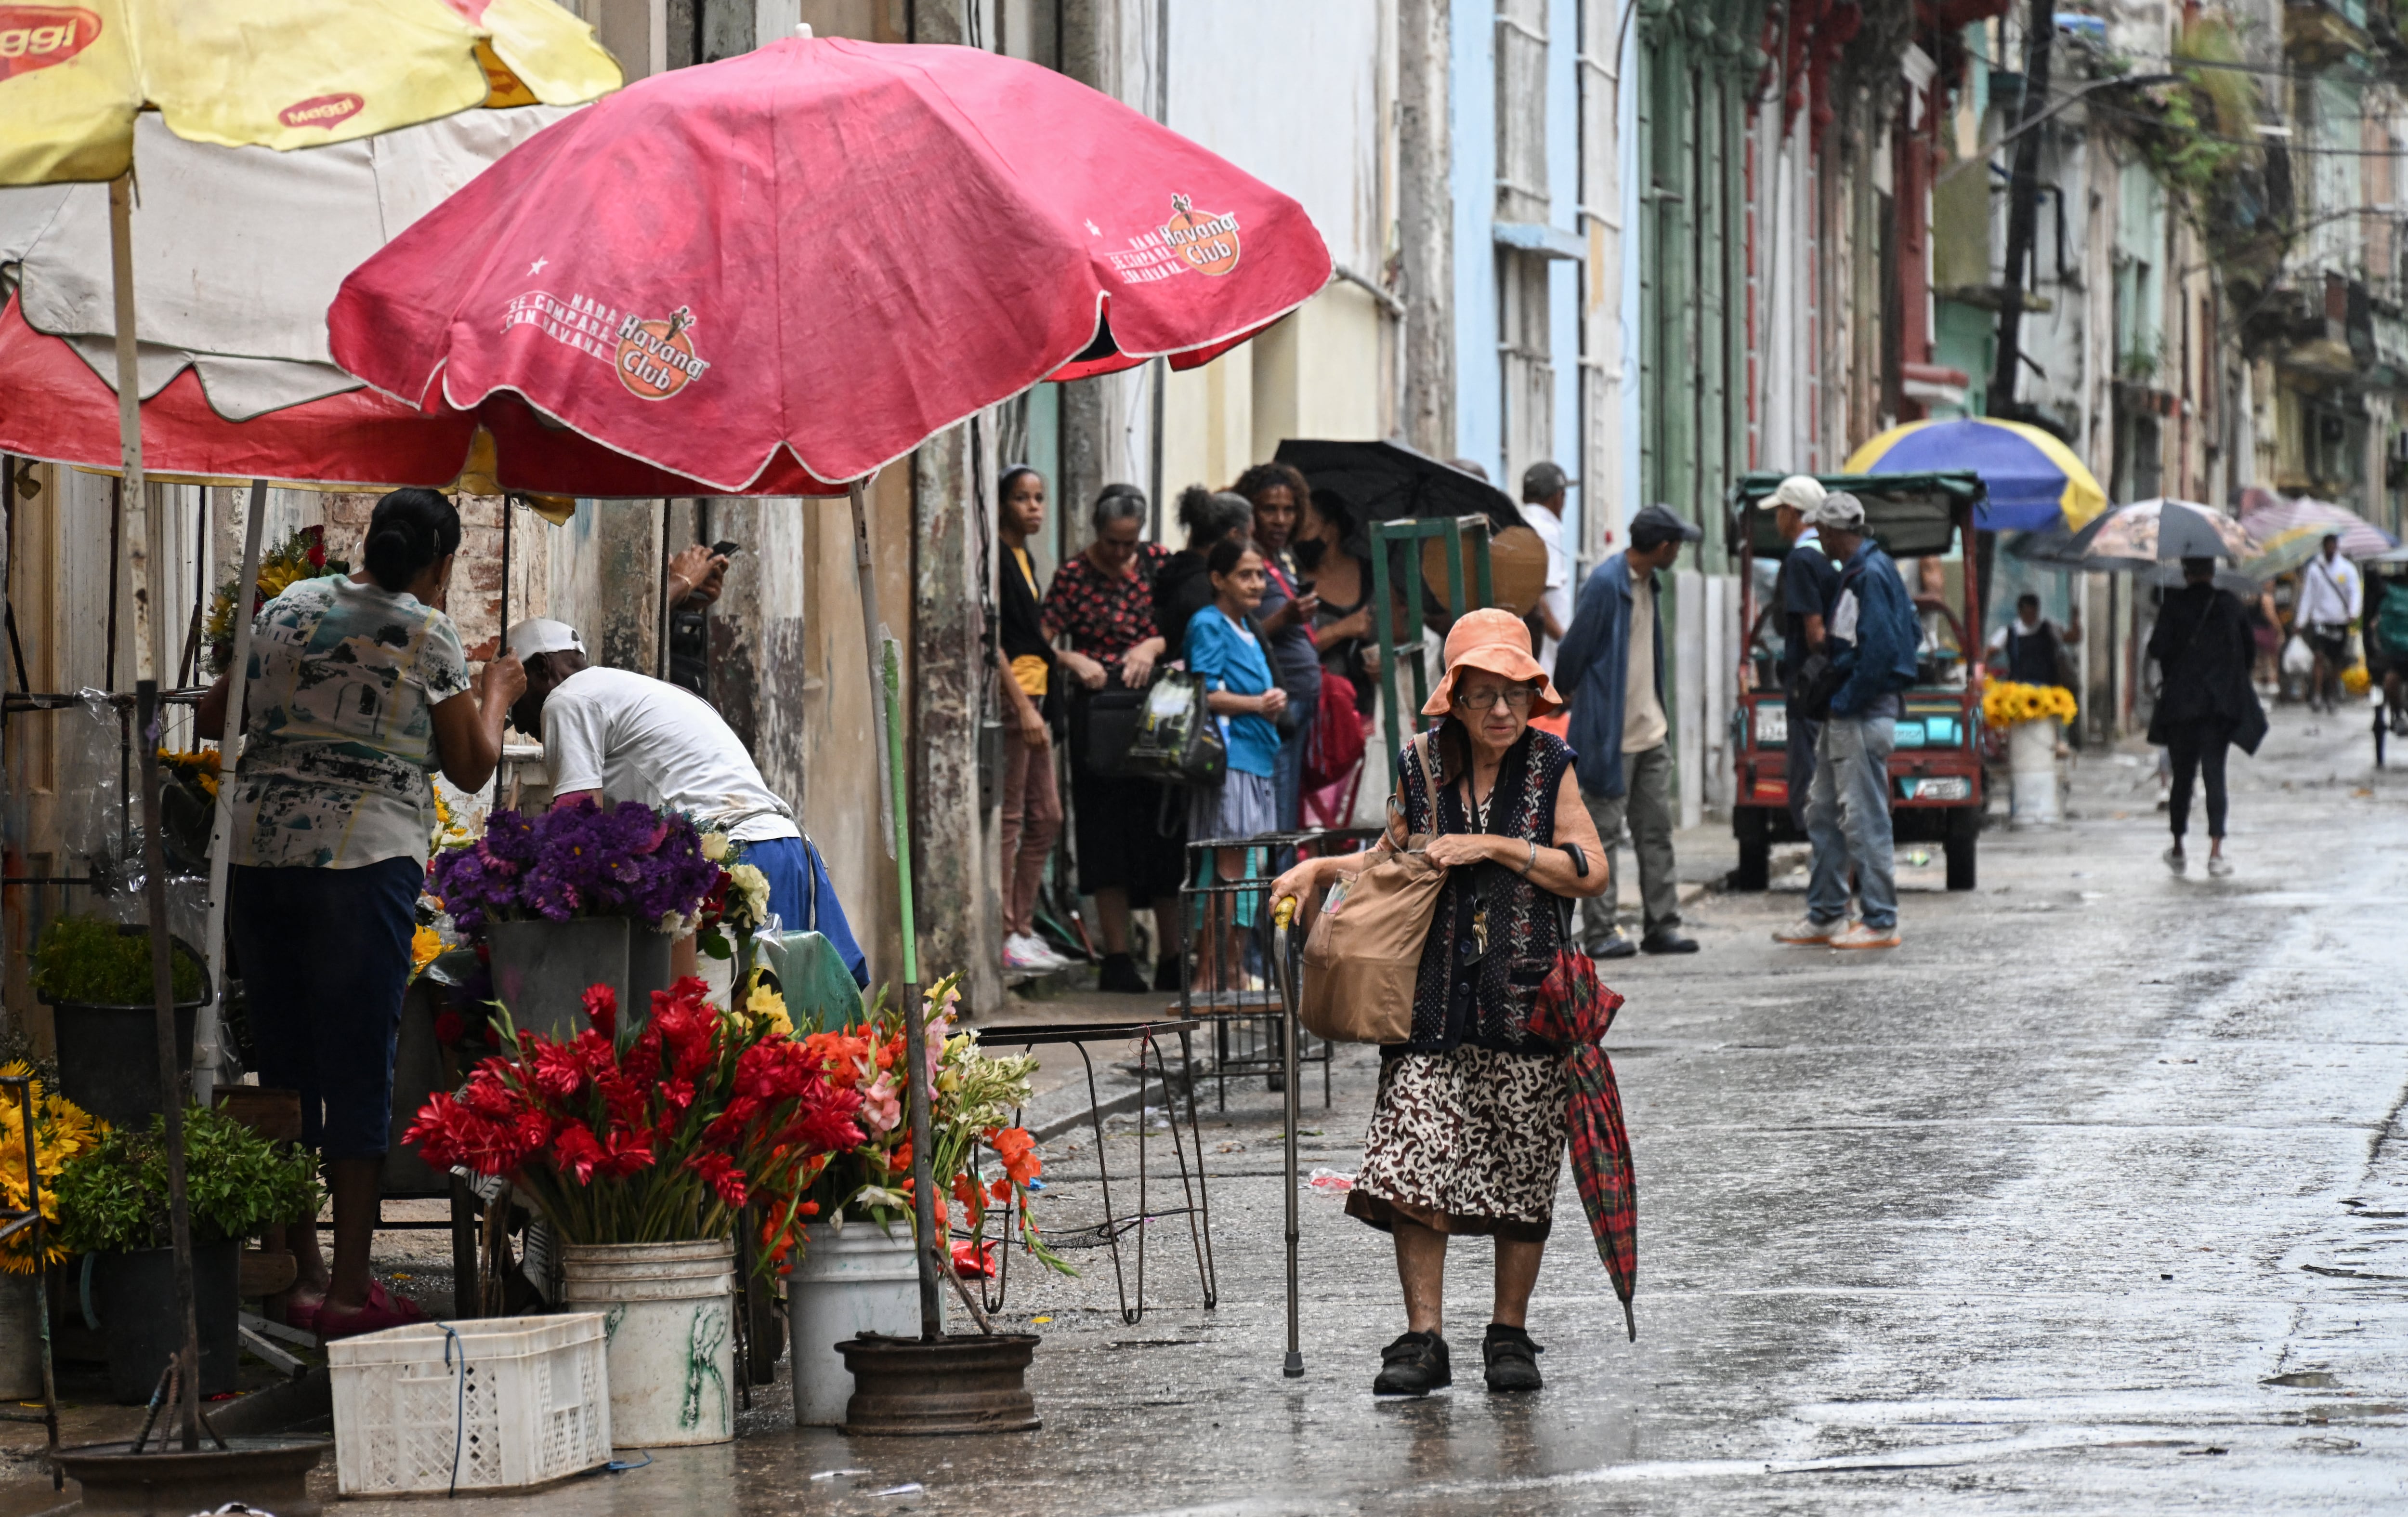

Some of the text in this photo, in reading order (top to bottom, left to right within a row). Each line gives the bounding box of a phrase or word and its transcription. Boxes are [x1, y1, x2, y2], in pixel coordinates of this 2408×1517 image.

[287, 97, 355, 125] Maggi
[1158, 215, 1238, 247] Havana
[1186, 239, 1232, 264] Club
[509, 294, 610, 342] SE COMPARA
[570, 293, 617, 325] NADA
[506, 309, 604, 356] CON HAVANA
[616, 313, 704, 379] Havana
[623, 350, 672, 391] Club
